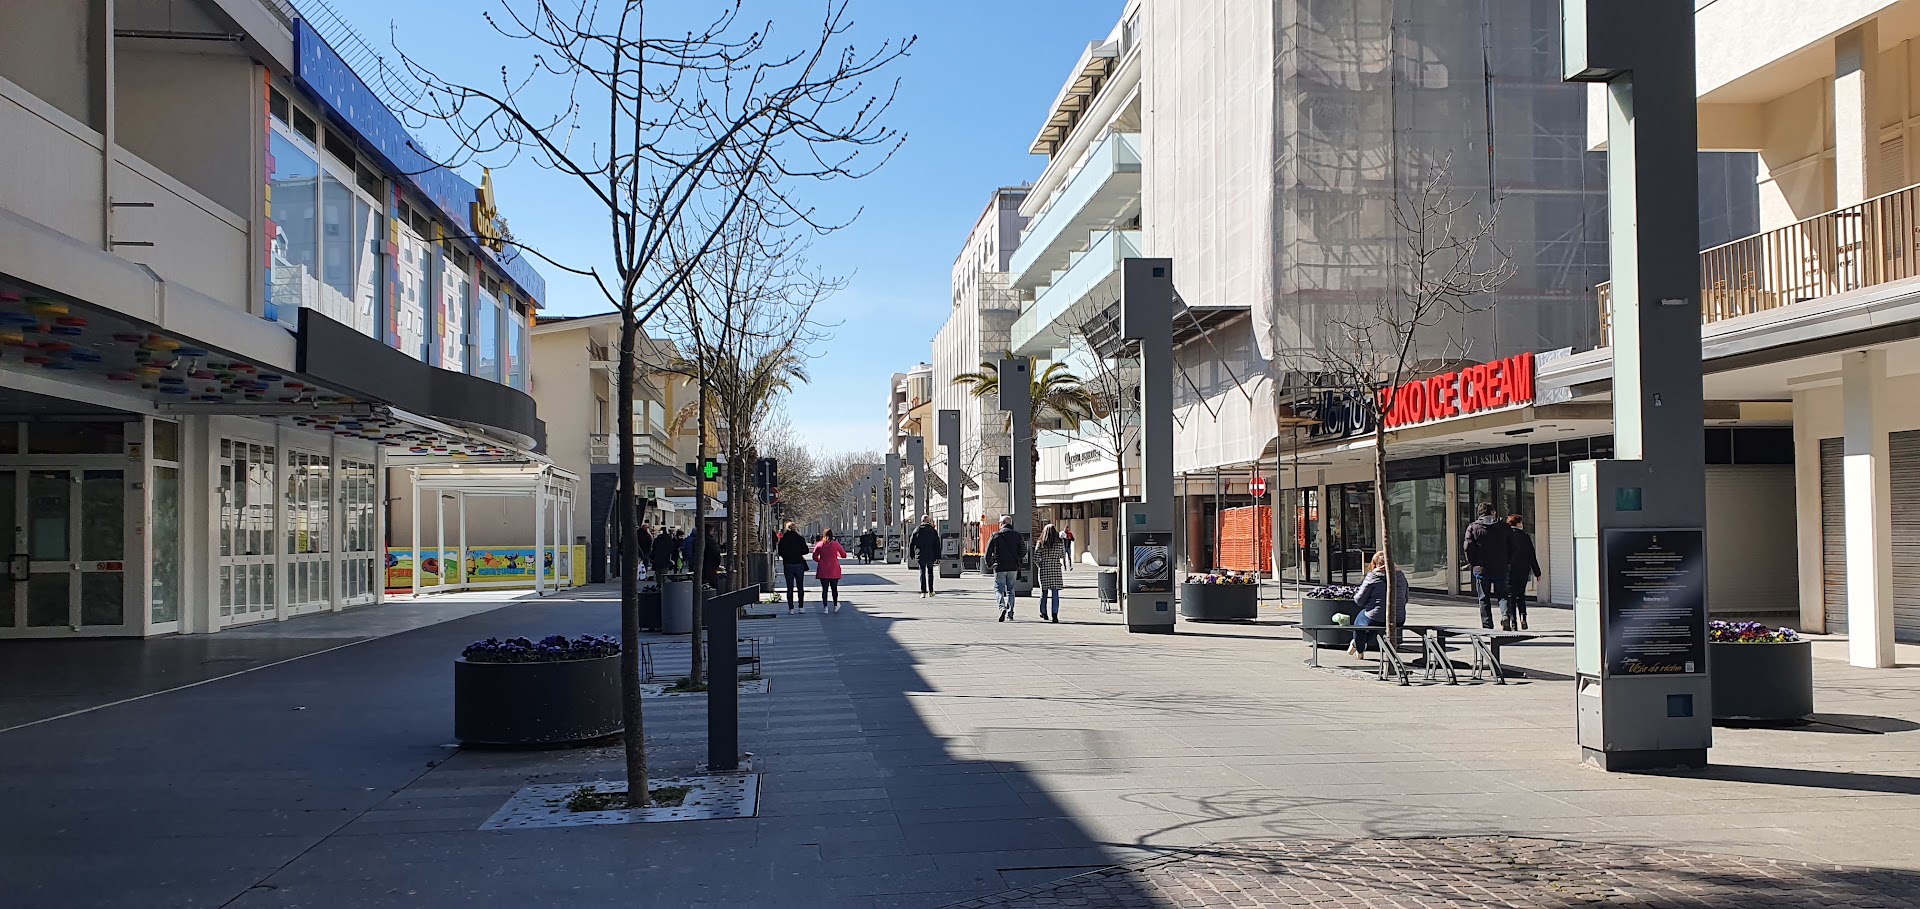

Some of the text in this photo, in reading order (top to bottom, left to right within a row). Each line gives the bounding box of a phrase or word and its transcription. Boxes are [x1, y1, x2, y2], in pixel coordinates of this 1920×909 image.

[1426, 371, 1459, 419] ICE
[1460, 352, 1534, 412] CREAM
[1463, 456, 1480, 467] PAUL
[1485, 451, 1511, 465] SHARK
